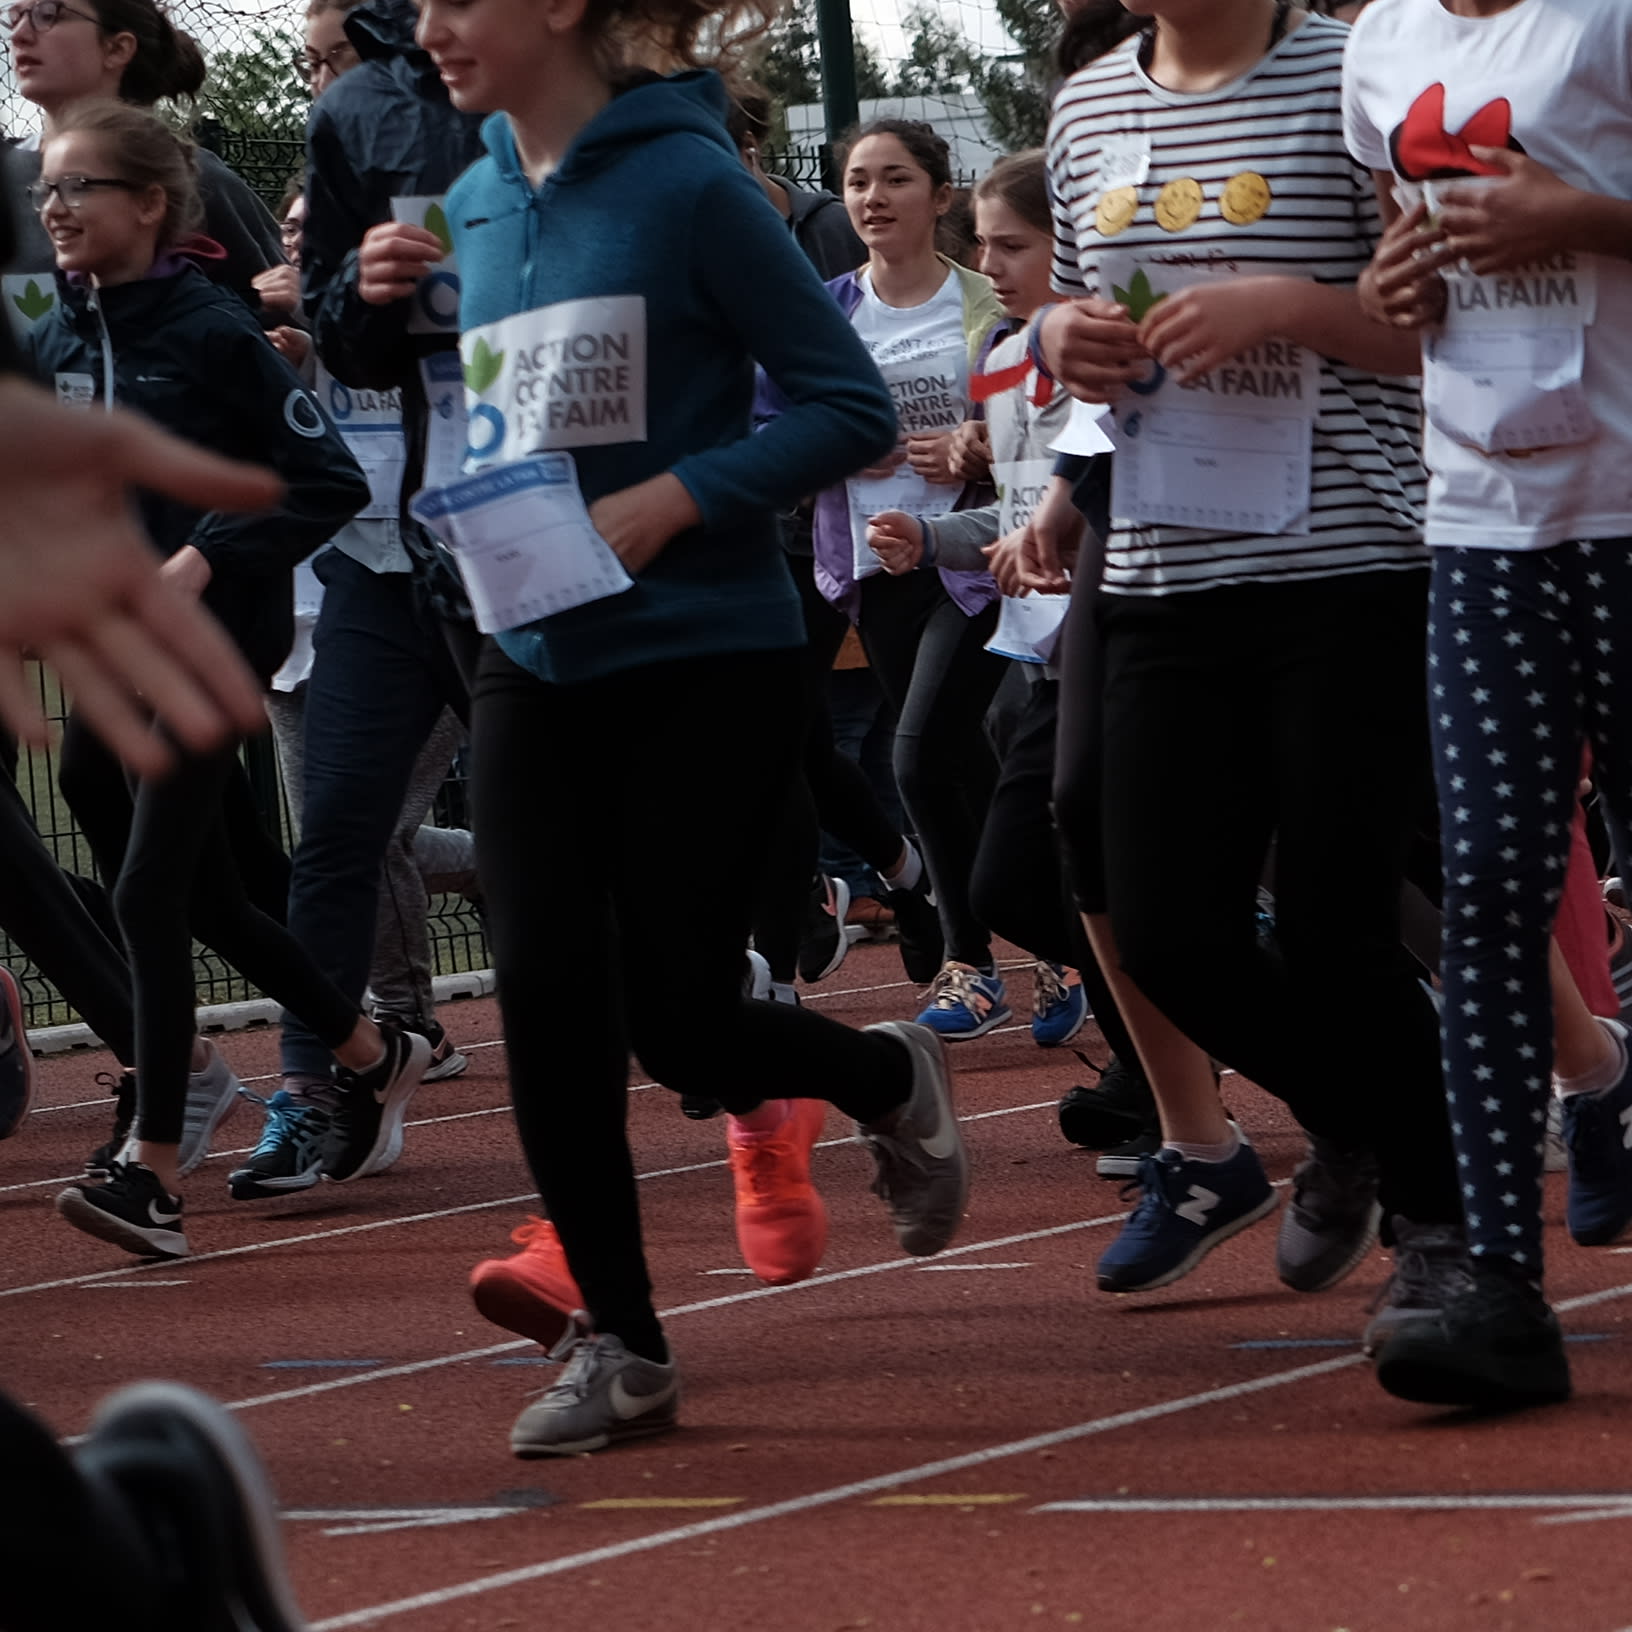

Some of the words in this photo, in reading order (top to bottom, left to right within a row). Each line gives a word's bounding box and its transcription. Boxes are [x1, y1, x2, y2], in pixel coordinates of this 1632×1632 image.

[1456, 279, 1490, 311] LA
[1495, 276, 1578, 310] FAIM
[514, 333, 630, 376] ACTION
[515, 366, 631, 407] CONTRE
[1221, 367, 1303, 400] FAIM
[357, 391, 377, 411] LA
[548, 396, 631, 430] FAIM
[908, 411, 958, 433] FAIM
